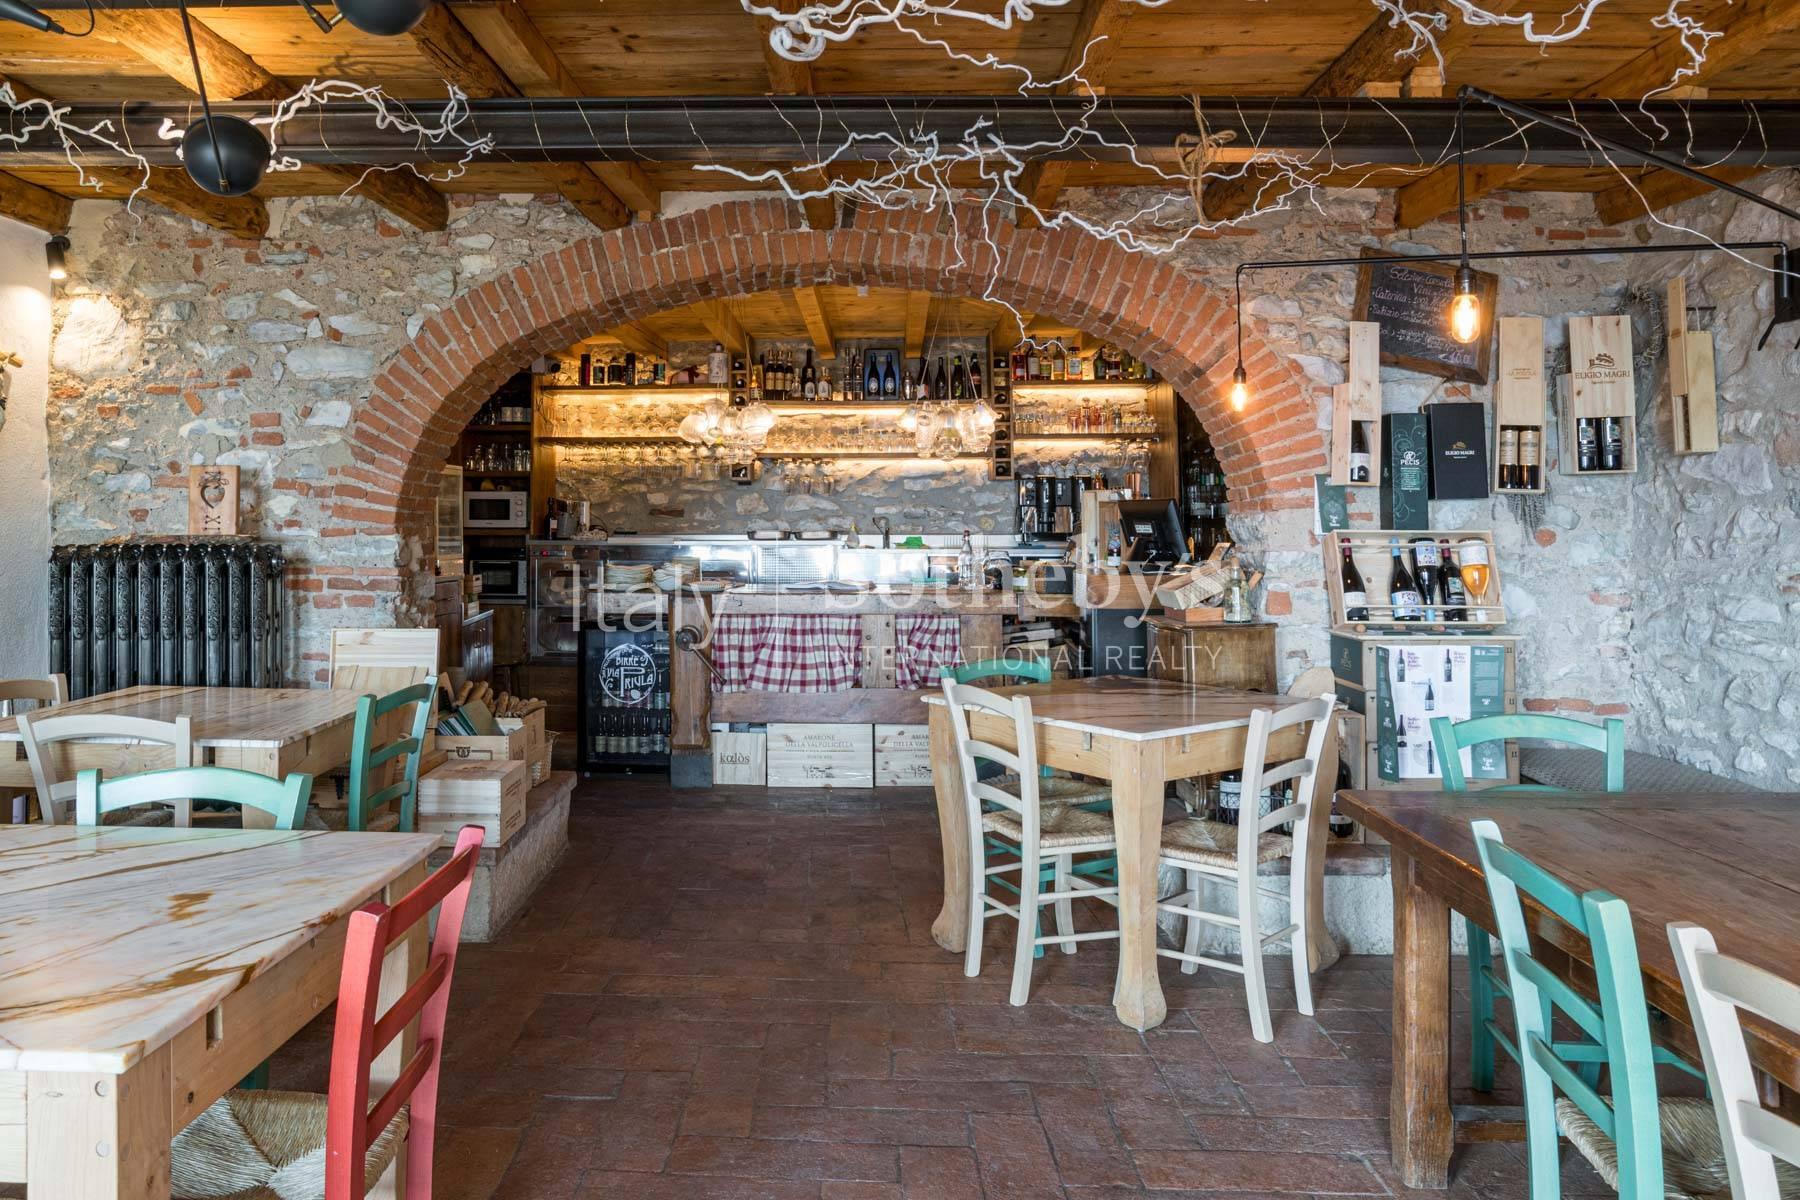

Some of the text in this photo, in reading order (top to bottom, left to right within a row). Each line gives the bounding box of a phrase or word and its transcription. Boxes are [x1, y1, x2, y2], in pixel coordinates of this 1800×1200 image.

[1575, 370, 1631, 379] ELIGIO MAGRI
[1400, 458, 1420, 466] PECIS
